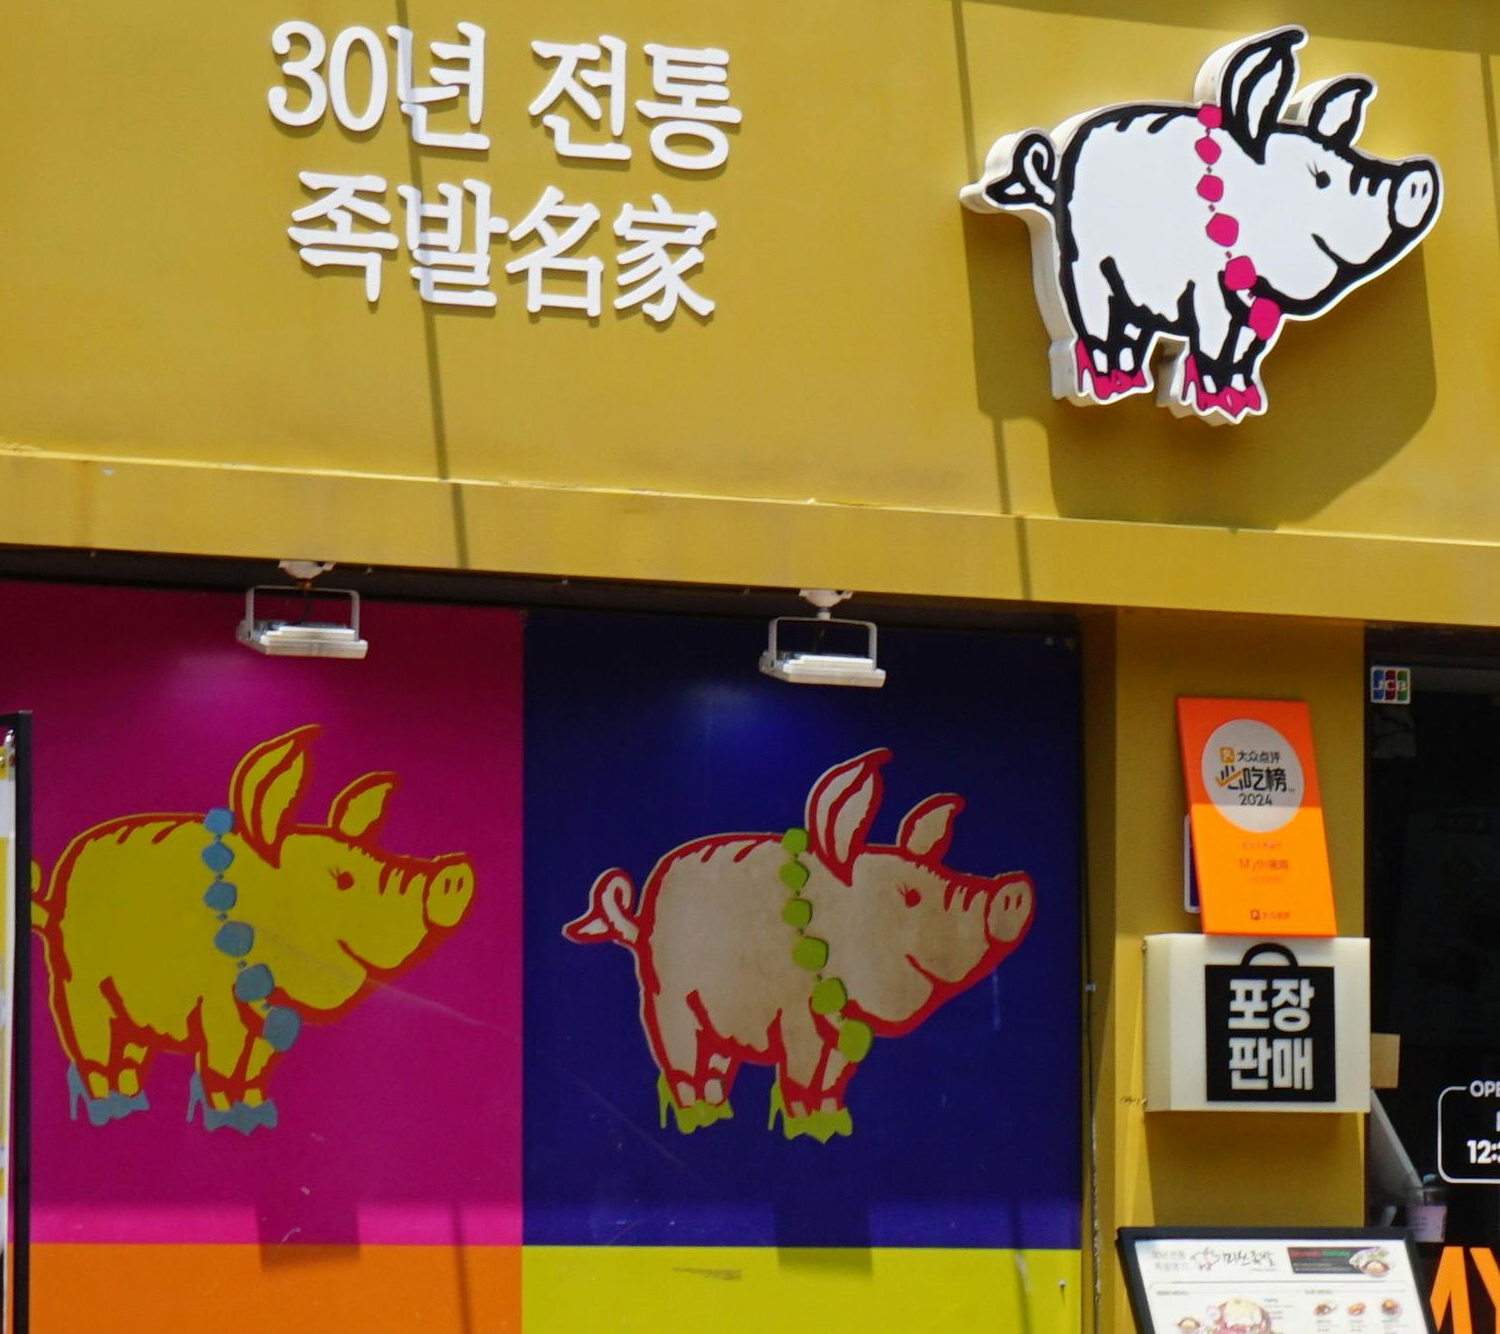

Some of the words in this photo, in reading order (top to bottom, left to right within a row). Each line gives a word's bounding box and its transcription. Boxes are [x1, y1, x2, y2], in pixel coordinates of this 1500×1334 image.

[268, 20, 491, 150] 30년
[528, 34, 742, 170] 전통
[287, 170, 717, 322] 족발名家
[1238, 793, 1273, 806] 2024
[1228, 978, 1314, 1033] 포장
[1228, 1037, 1314, 1091] 판매
